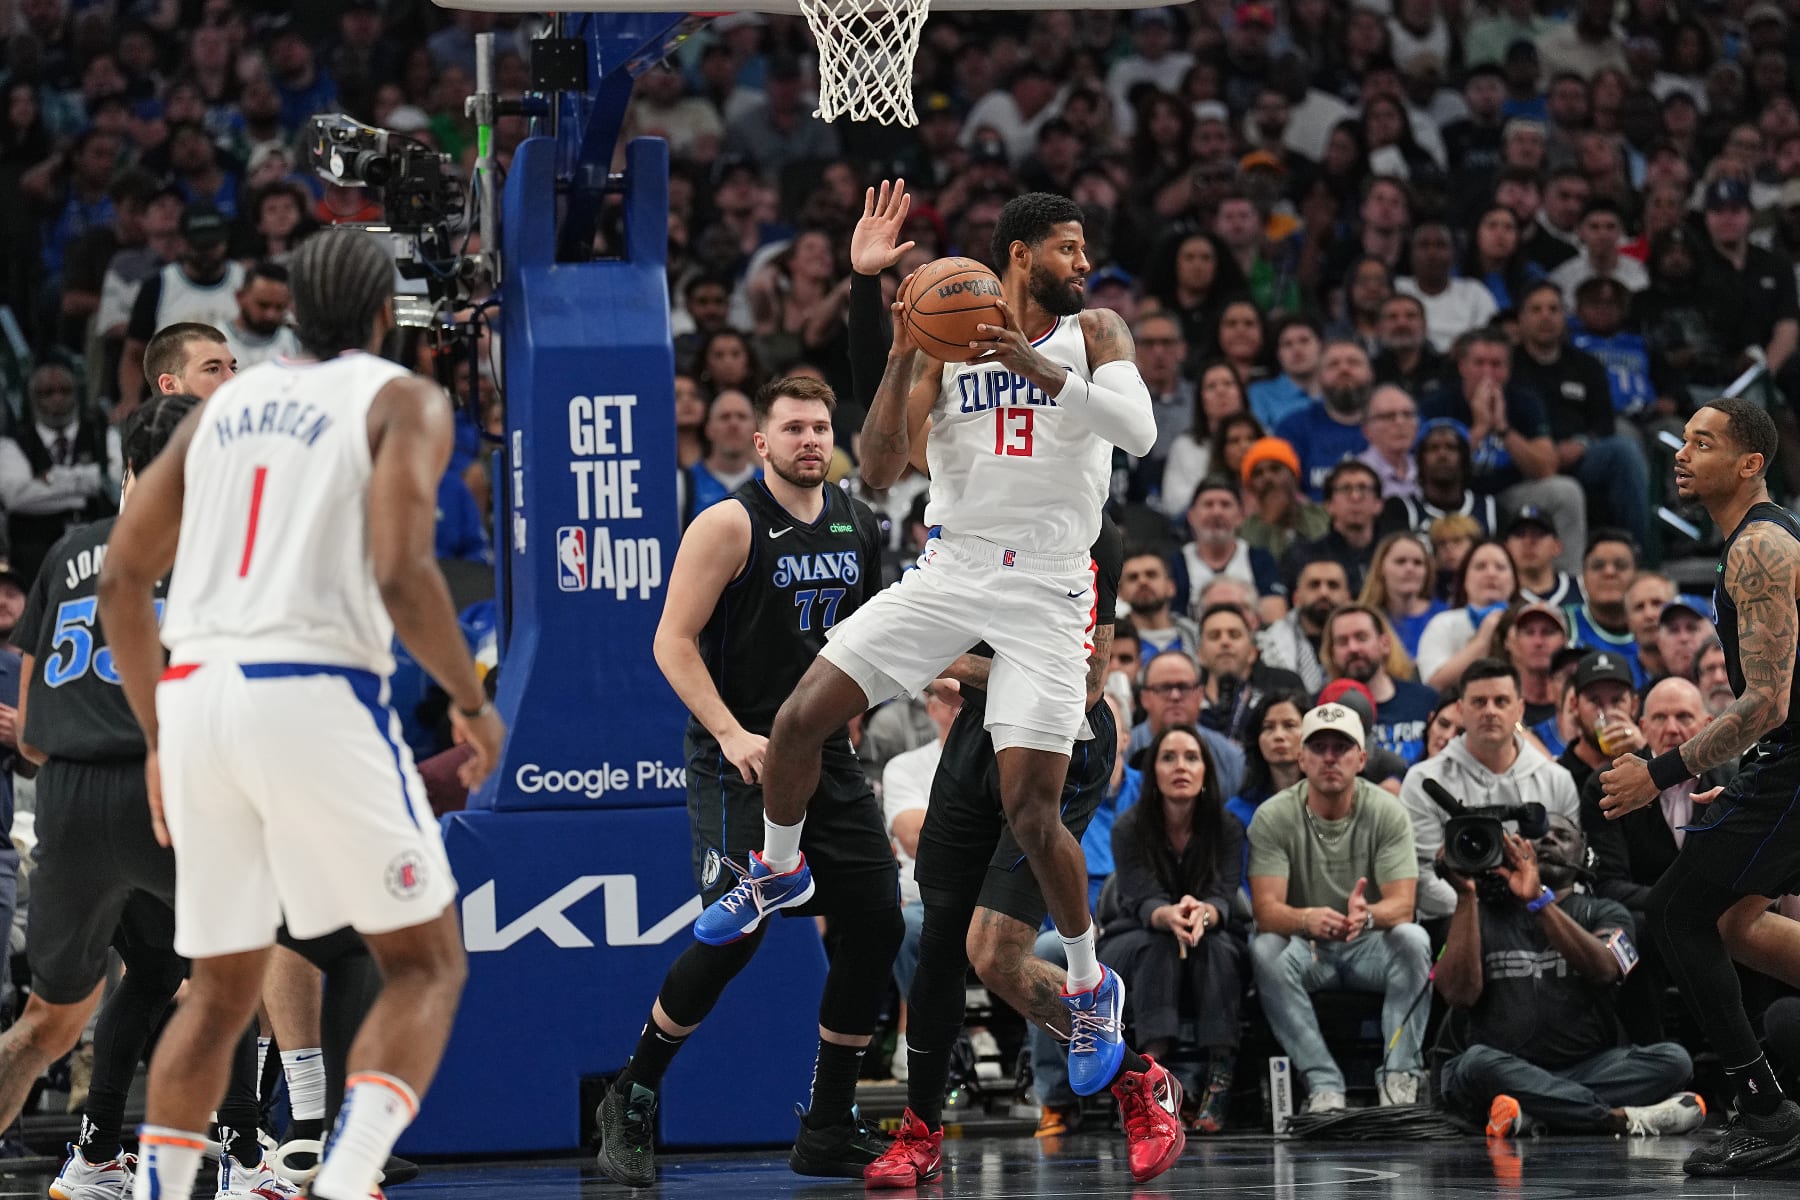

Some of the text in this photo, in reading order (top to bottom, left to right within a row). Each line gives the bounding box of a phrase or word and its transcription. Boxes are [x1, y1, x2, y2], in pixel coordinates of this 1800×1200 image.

[937, 279, 1002, 298] Wilson
[958, 366, 1072, 413] CLIPPE
[216, 401, 333, 448] HARDEN
[569, 395, 637, 456] GET
[995, 407, 1034, 457] 13
[570, 459, 643, 520] THE
[238, 465, 267, 578] 1
[829, 523, 853, 533] chime
[65, 544, 109, 590] JON
[591, 526, 662, 600] App
[773, 550, 860, 588] MAVS
[795, 588, 846, 631] 77
[516, 761, 687, 799] Google Pix
